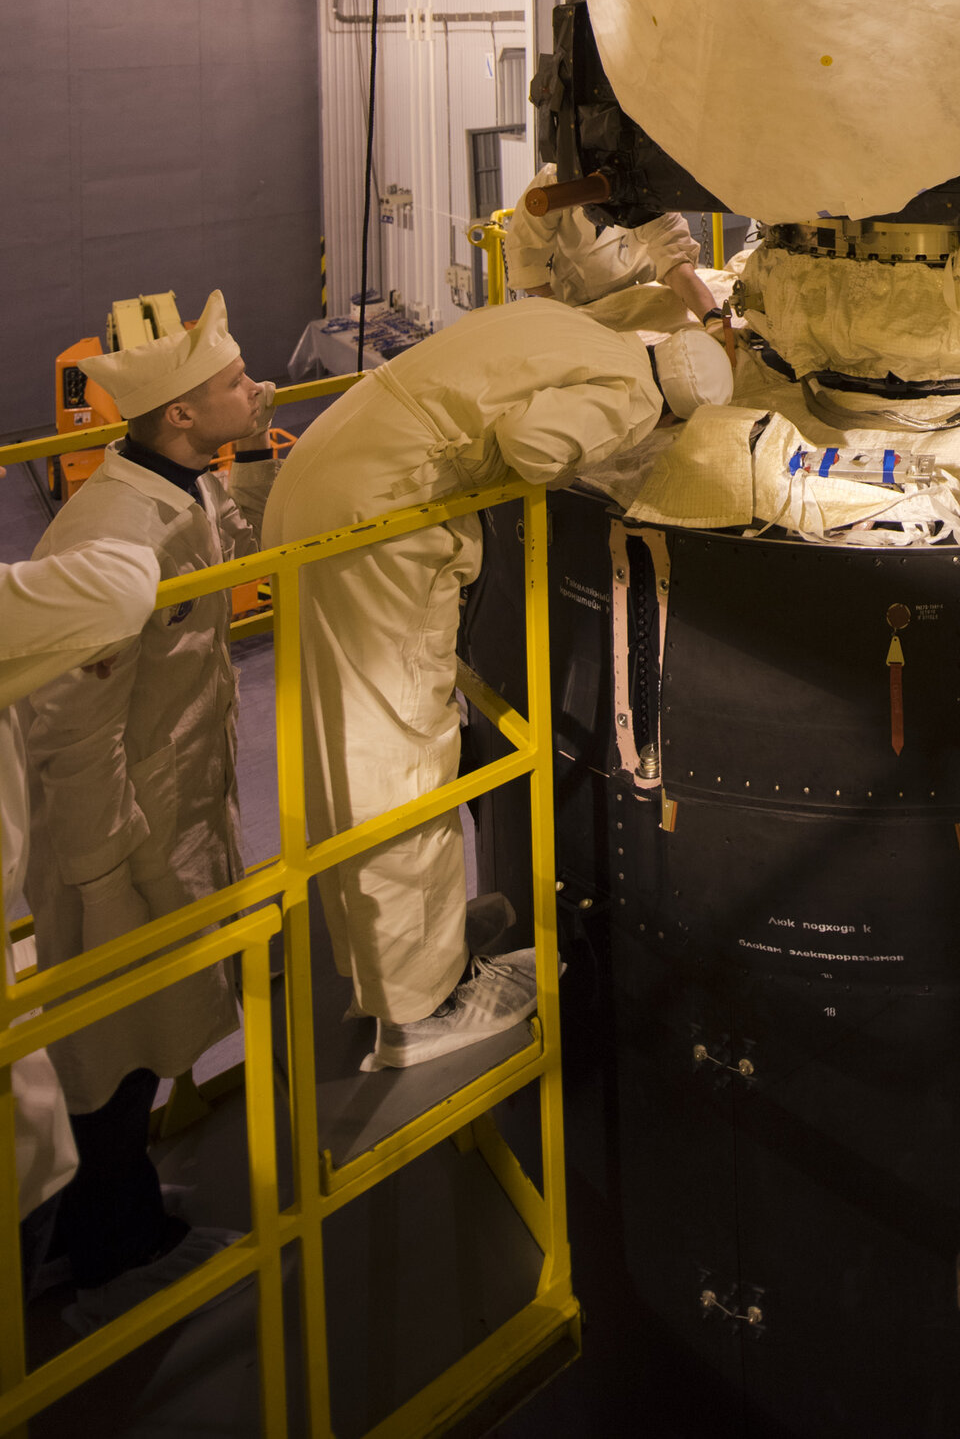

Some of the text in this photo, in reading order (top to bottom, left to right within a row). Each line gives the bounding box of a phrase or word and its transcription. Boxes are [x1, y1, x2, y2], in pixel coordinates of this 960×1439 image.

[768, 916, 796, 928] Люк
[802, 921, 856, 934] подхода
[738, 939, 905, 962] блокам электроразъемов
[823, 1006, 837, 1018] 18
